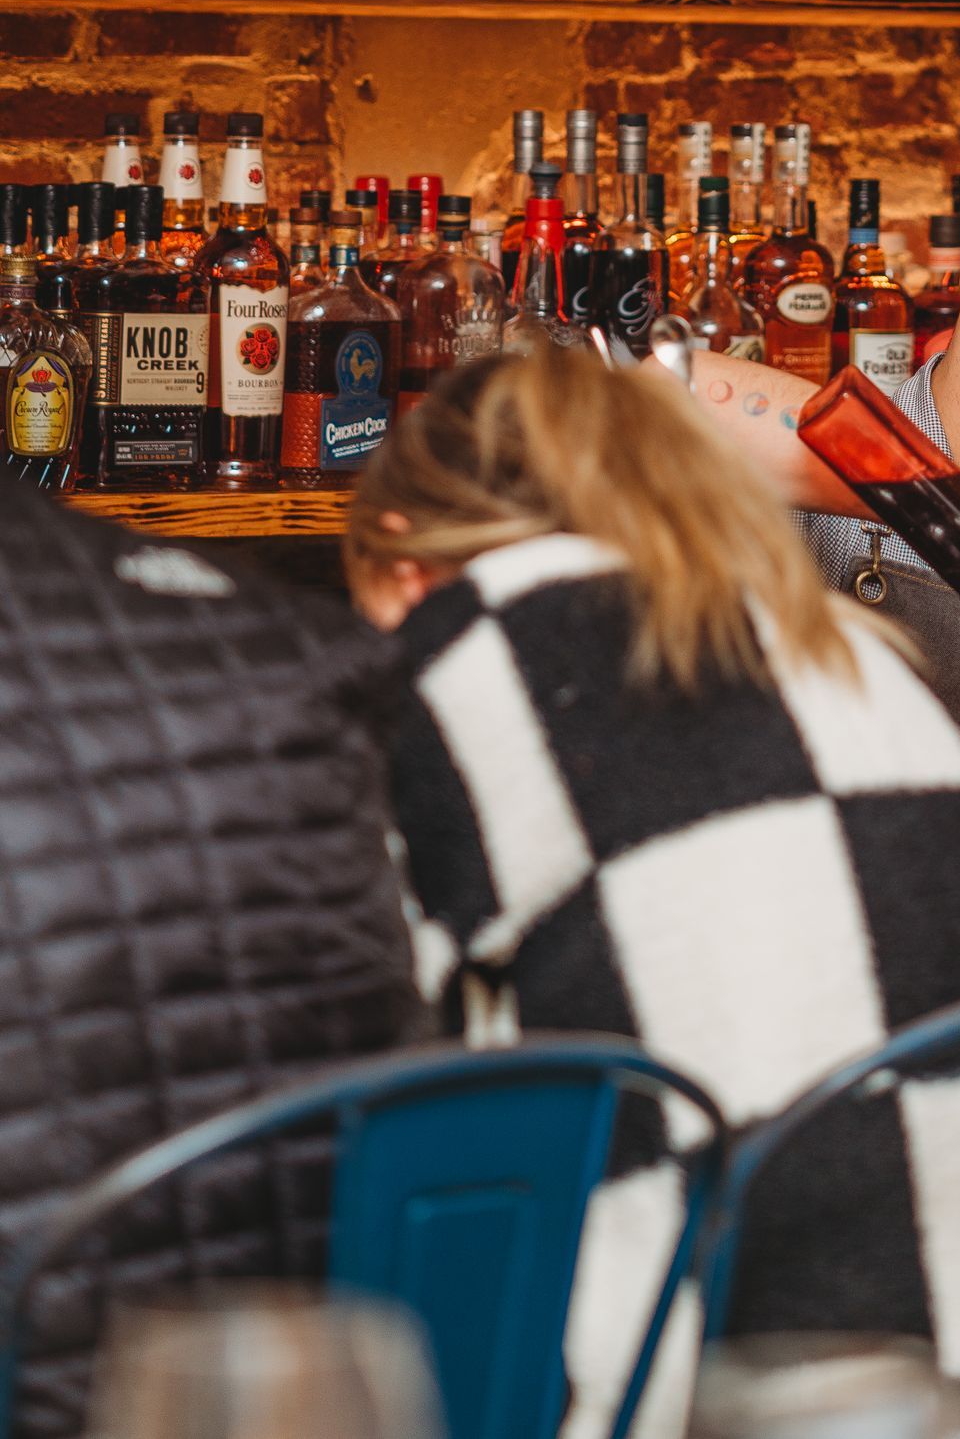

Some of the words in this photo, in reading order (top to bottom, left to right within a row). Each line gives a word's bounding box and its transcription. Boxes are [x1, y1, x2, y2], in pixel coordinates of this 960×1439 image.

[227, 300, 258, 318] Four
[259, 301, 287, 319] Roses
[101, 317, 109, 344] YEARS
[126, 326, 188, 358] KNOB
[100, 345, 108, 366] NINE
[137, 360, 199, 371] CREEK
[99, 367, 107, 389] AGED
[196, 372, 205, 394] 9
[238, 379, 279, 388] BOURBON
[14, 400, 38, 417] Crown
[33, 400, 63, 418] Royal
